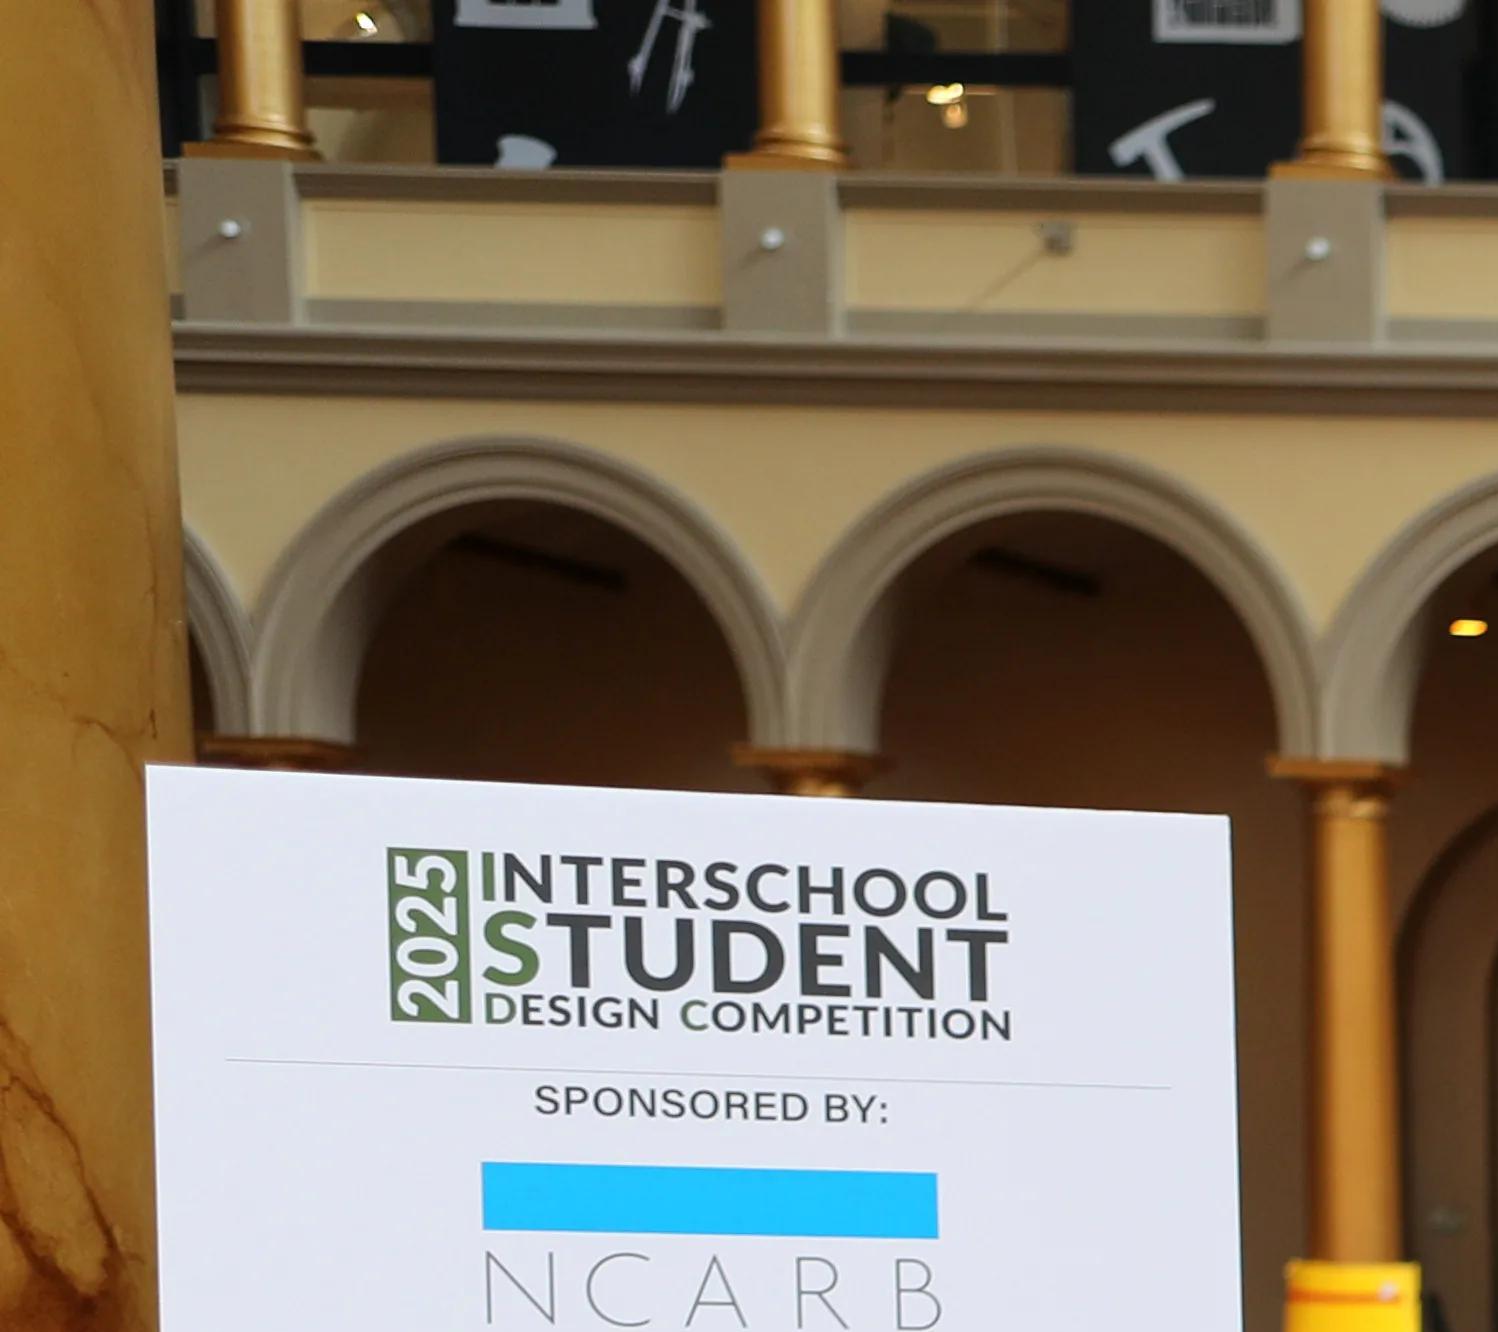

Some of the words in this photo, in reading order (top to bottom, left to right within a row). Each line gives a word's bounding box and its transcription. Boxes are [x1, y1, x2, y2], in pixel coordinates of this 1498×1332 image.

[481, 851, 1008, 922] INTERSCHOOL
[395, 855, 460, 1019] 2025
[481, 909, 1009, 1000] STUDENT
[484, 992, 659, 1030] DESIGN
[679, 999, 1011, 1041] COMPETITION
[534, 1084, 809, 1121] SPONSORED
[824, 1093, 887, 1124] BY:
[484, 1250, 942, 1331] NCARB
